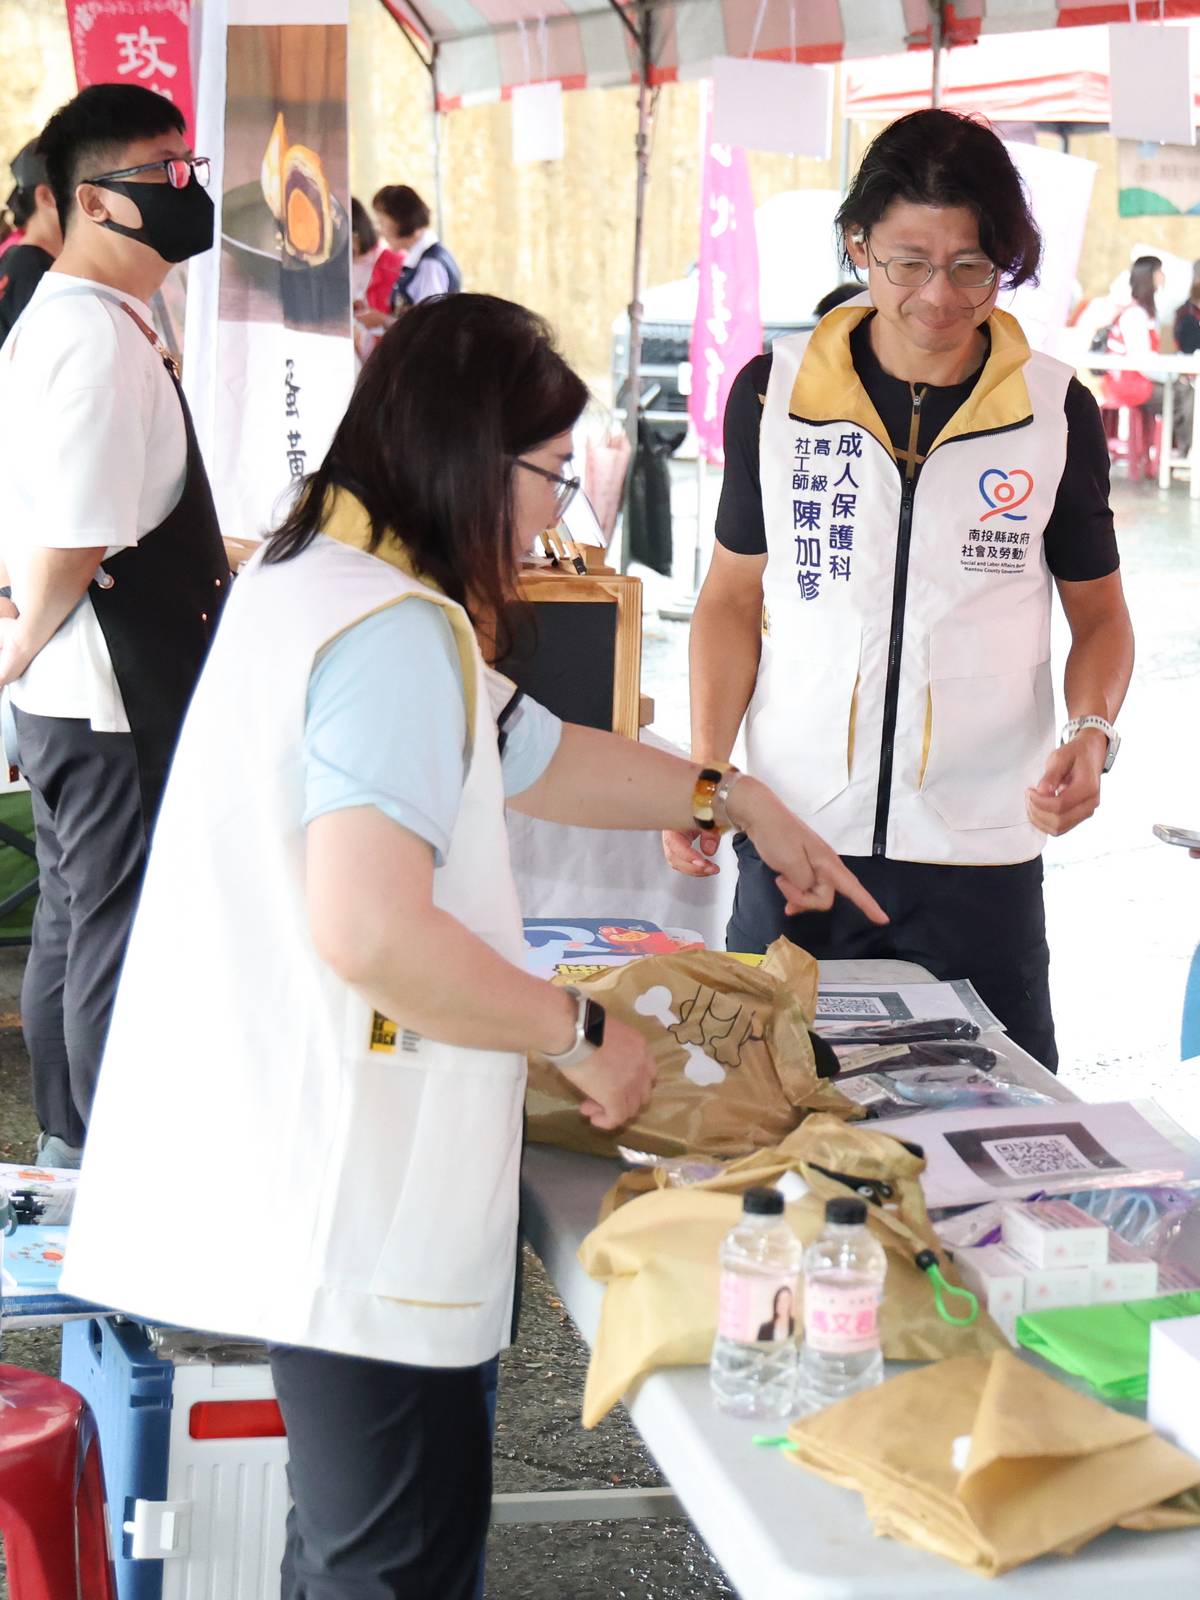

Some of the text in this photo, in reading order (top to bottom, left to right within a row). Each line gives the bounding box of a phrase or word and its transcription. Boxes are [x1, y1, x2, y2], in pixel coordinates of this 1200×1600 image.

[115, 25, 178, 101] 玫
[792, 437, 811, 490] 社工師
[829, 432, 863, 581] 成人保護科
[968, 529, 1030, 545] 南投縣政府
[793, 500, 822, 601] 陳加修
[961, 544, 1028, 560] 社會及勞動
